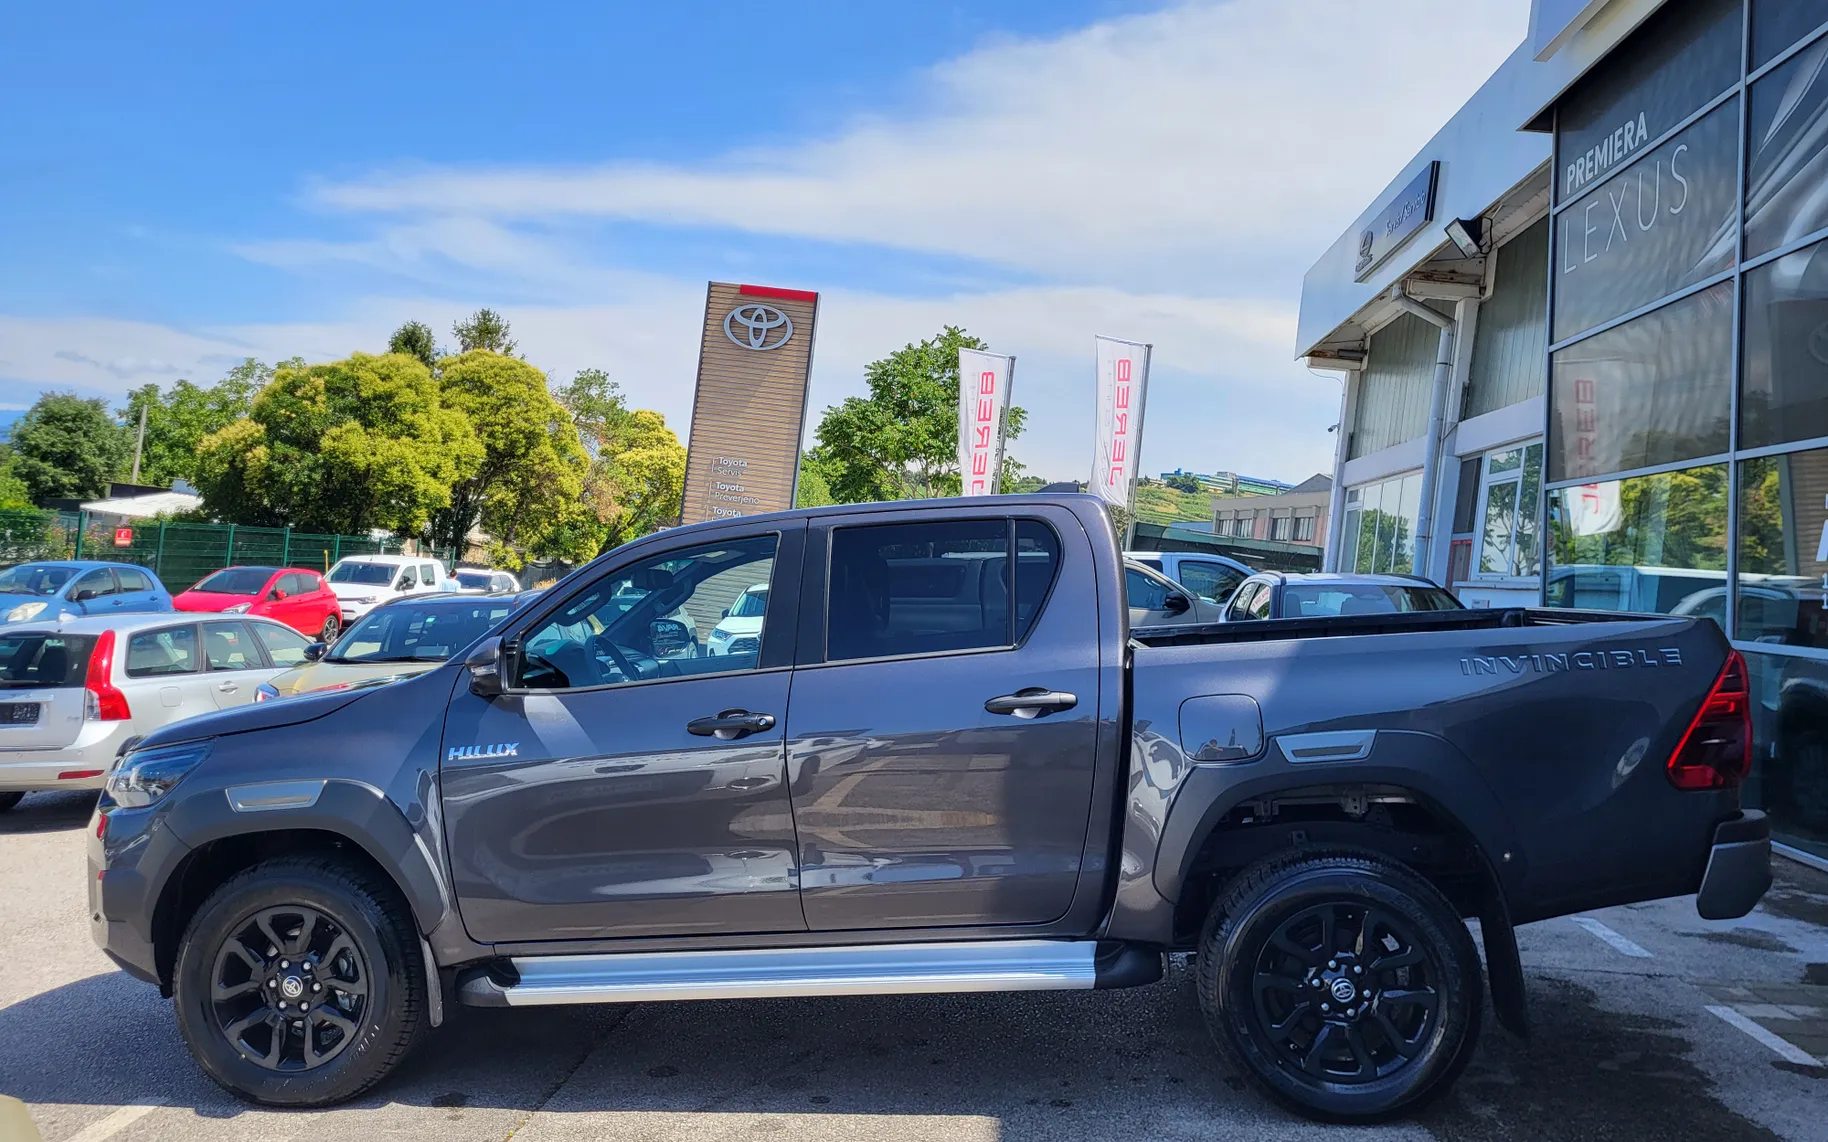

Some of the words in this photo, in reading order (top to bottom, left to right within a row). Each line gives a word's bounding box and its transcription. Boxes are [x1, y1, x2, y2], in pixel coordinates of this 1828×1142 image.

[1566, 111, 1648, 194] PREMIERA
[1564, 144, 1688, 274] LEXUS
[719, 456, 748, 467] Toyota
[717, 467, 742, 476] Servis
[716, 481, 745, 492] Toyota
[715, 491, 760, 504] Preverjeno
[712, 505, 742, 517] Toyota
[1459, 648, 1683, 676] INVINCIBLE
[448, 742, 520, 760] HILUX
